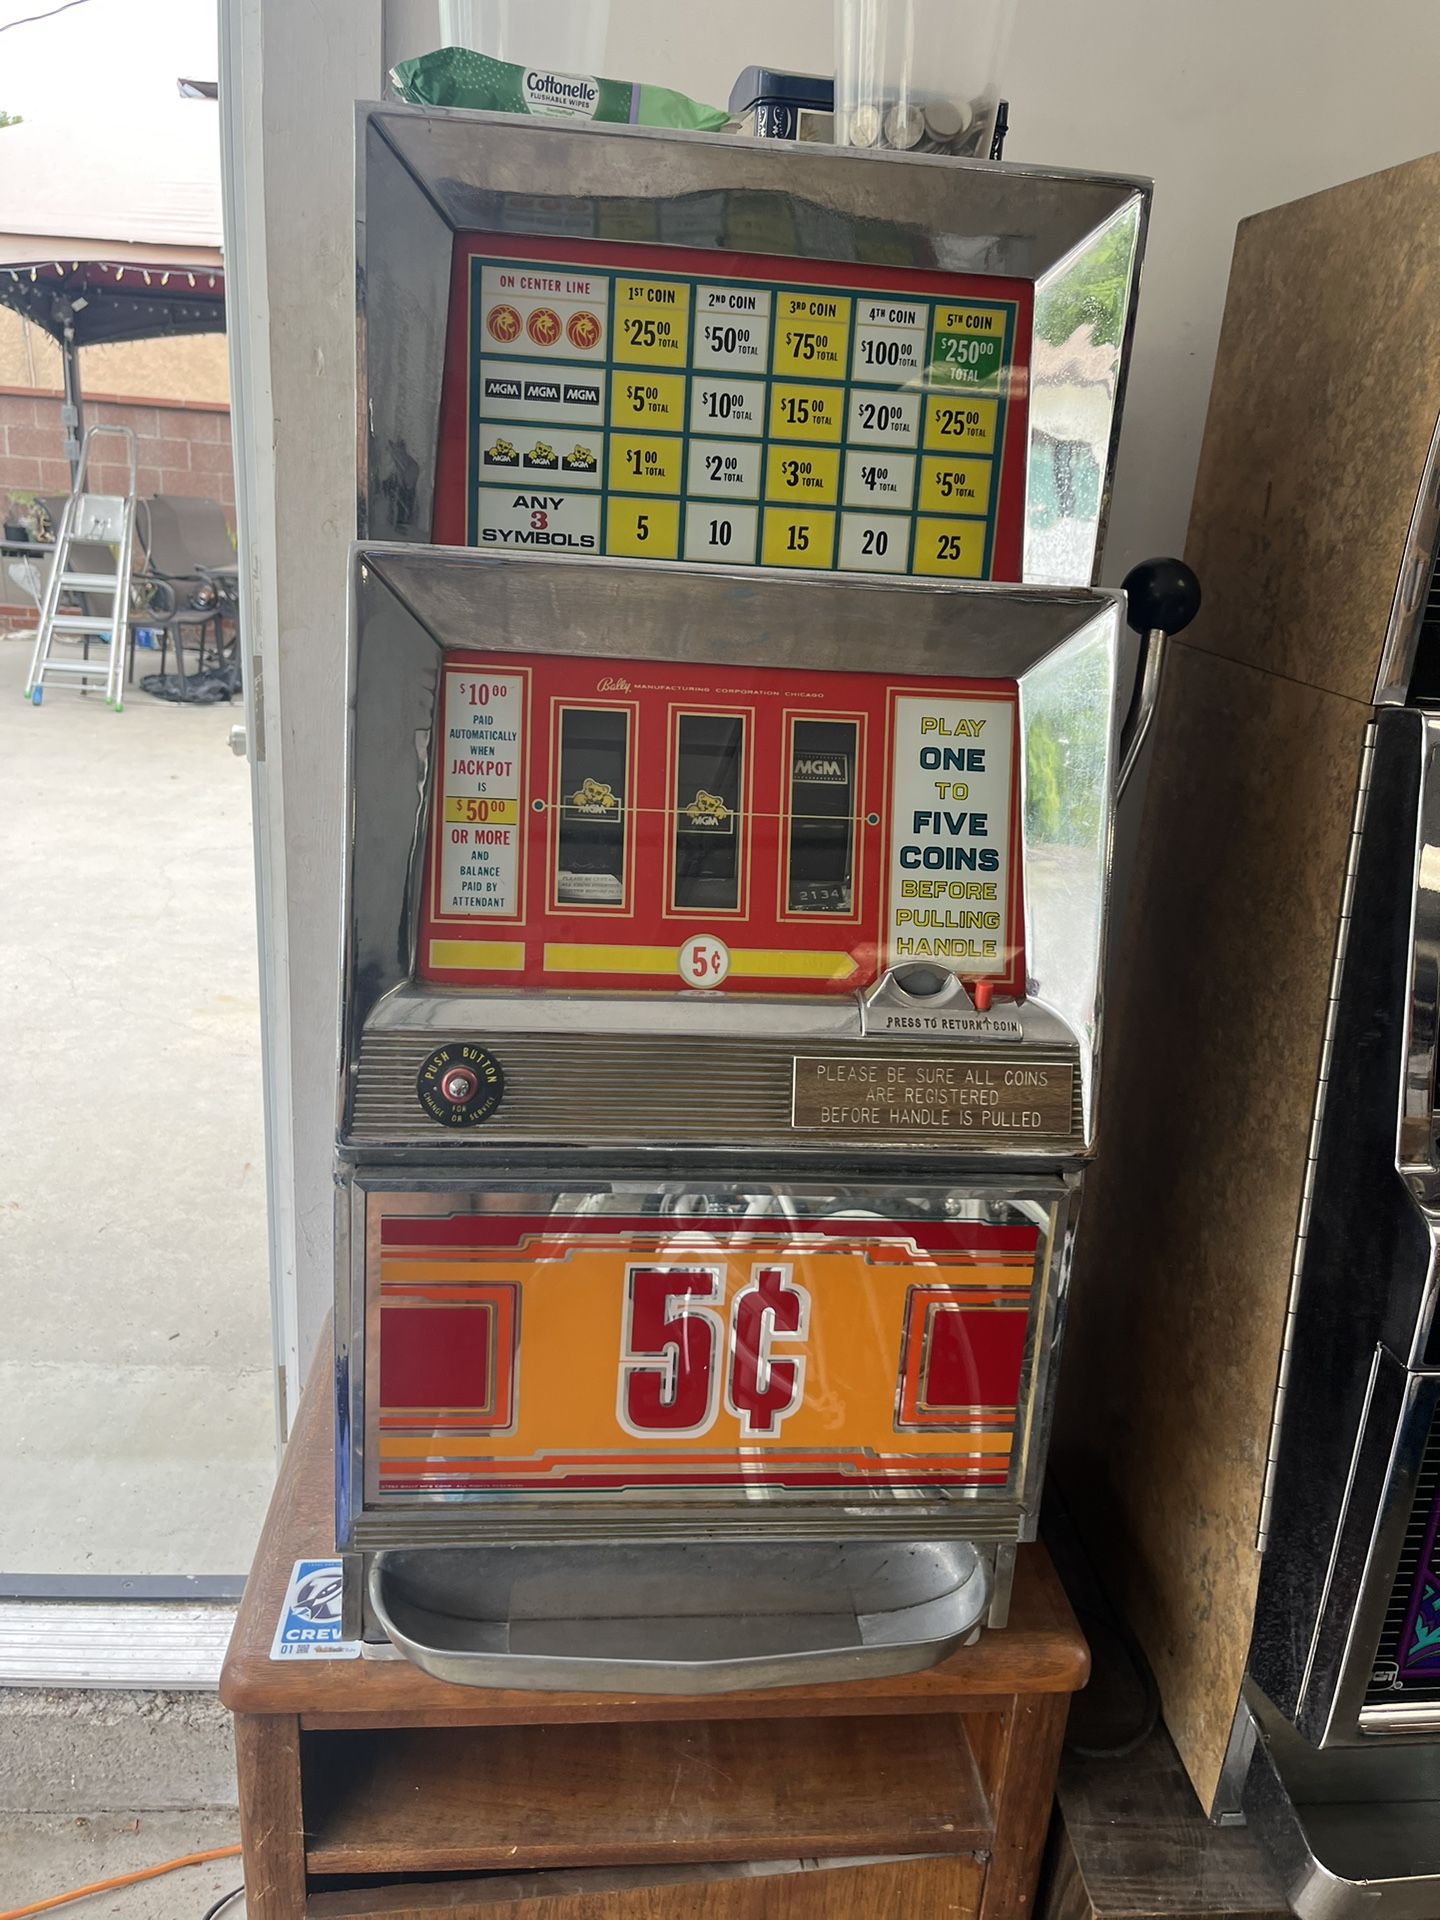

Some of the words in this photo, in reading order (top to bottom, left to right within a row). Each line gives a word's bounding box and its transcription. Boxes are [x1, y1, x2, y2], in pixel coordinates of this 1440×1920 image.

[527, 72, 595, 100] Cottonelle
[530, 92, 567, 104] FLUSHABLE
[568, 99, 590, 108] WIPES
[500, 275, 514, 288] ON
[520, 277, 561, 293] CENTER
[566, 281, 591, 295] LINE
[628, 287, 643, 301] 1ST
[647, 288, 675, 304] COIN
[708, 294, 726, 307] 2ND
[729, 295, 756, 310] COIN
[789, 301, 806, 314] 3RD
[810, 302, 836, 318] COIN
[869, 308, 886, 321] 4TH
[888, 309, 916, 324] COIN
[946, 314, 963, 327] 5TH
[966, 315, 993, 330] COIN
[658, 338, 678, 349] TOTAL
[738, 345, 758, 355] TOTAL
[816, 350, 838, 362] TOTAL
[899, 358, 917, 368] TOTAL
[950, 367, 978, 382] TOTAL
[488, 382, 518, 396] MGM
[527, 385, 558, 399] MGM
[566, 388, 597, 402] MGM
[648, 402, 669, 413] TOTAL
[732, 410, 753, 421] TOTAL
[812, 416, 832, 426] TOTAL
[890, 422, 910, 432] TOTAL
[966, 427, 986, 438] TOTAL
[645, 466, 666, 478] TOTAL
[724, 472, 744, 482] TOTAL
[802, 477, 824, 488] TOTAL
[879, 482, 897, 492] TOTAL
[955, 488, 975, 498] TOTAL
[512, 495, 564, 510] ANY
[530, 511, 548, 530] 3
[636, 515, 649, 541] 5
[482, 528, 595, 548] SYMBOLS
[708, 520, 732, 546] 10
[787, 525, 809, 551] 15
[861, 529, 888, 556] 20
[936, 535, 962, 561] 25
[596, 676, 632, 694] Bally
[634, 684, 710, 693] MANUFACTURING
[715, 688, 780, 696] CORPORATION
[472, 715, 494, 726] PAID
[920, 716, 987, 737] PLAY
[450, 728, 517, 742] AUTOMATICALLY
[470, 745, 495, 756] WHEN
[920, 746, 986, 772] ONE
[452, 760, 512, 777] JACKPOT
[794, 759, 842, 776] MGM
[478, 782, 487, 792] IS
[934, 782, 969, 800] TO
[691, 816, 720, 826] MGM
[913, 810, 988, 837] FIVE
[451, 828, 468, 844] OR
[474, 830, 511, 846] MORE
[471, 850, 490, 861] AND
[900, 846, 1000, 872] COINS
[460, 866, 500, 877] BALANCE
[462, 881, 482, 892] PAID
[486, 882, 498, 892] BY
[901, 880, 998, 901] BEFORE
[452, 896, 505, 908] ATTENDANT
[896, 908, 1000, 930] PULLING
[896, 937, 997, 958] HANDLE
[692, 946, 721, 977] 5¢
[886, 1016, 922, 1028] PRESS
[923, 1017, 937, 1029] TO
[942, 1018, 983, 1031] RETURN
[992, 1020, 1018, 1032] COIN
[424, 1051, 450, 1080] PUSH
[462, 1046, 498, 1083] BUTTON
[817, 1065, 878, 1083] PLEASE
[887, 1067, 906, 1084] BE
[915, 1068, 955, 1085] SURE
[965, 1068, 994, 1086] ALL
[1004, 1070, 1048, 1088] COINS
[423, 1092, 444, 1118] CHANGE
[866, 1087, 895, 1103] ARE
[905, 1088, 999, 1106] REGISTERED
[820, 1106, 880, 1124] BEFORE
[890, 1108, 950, 1126] HANDLE
[960, 1110, 973, 1126] IS
[982, 1111, 1042, 1128] PULLED
[616, 1262, 810, 1438] 5¢
[280, 1644, 294, 1655] 01
